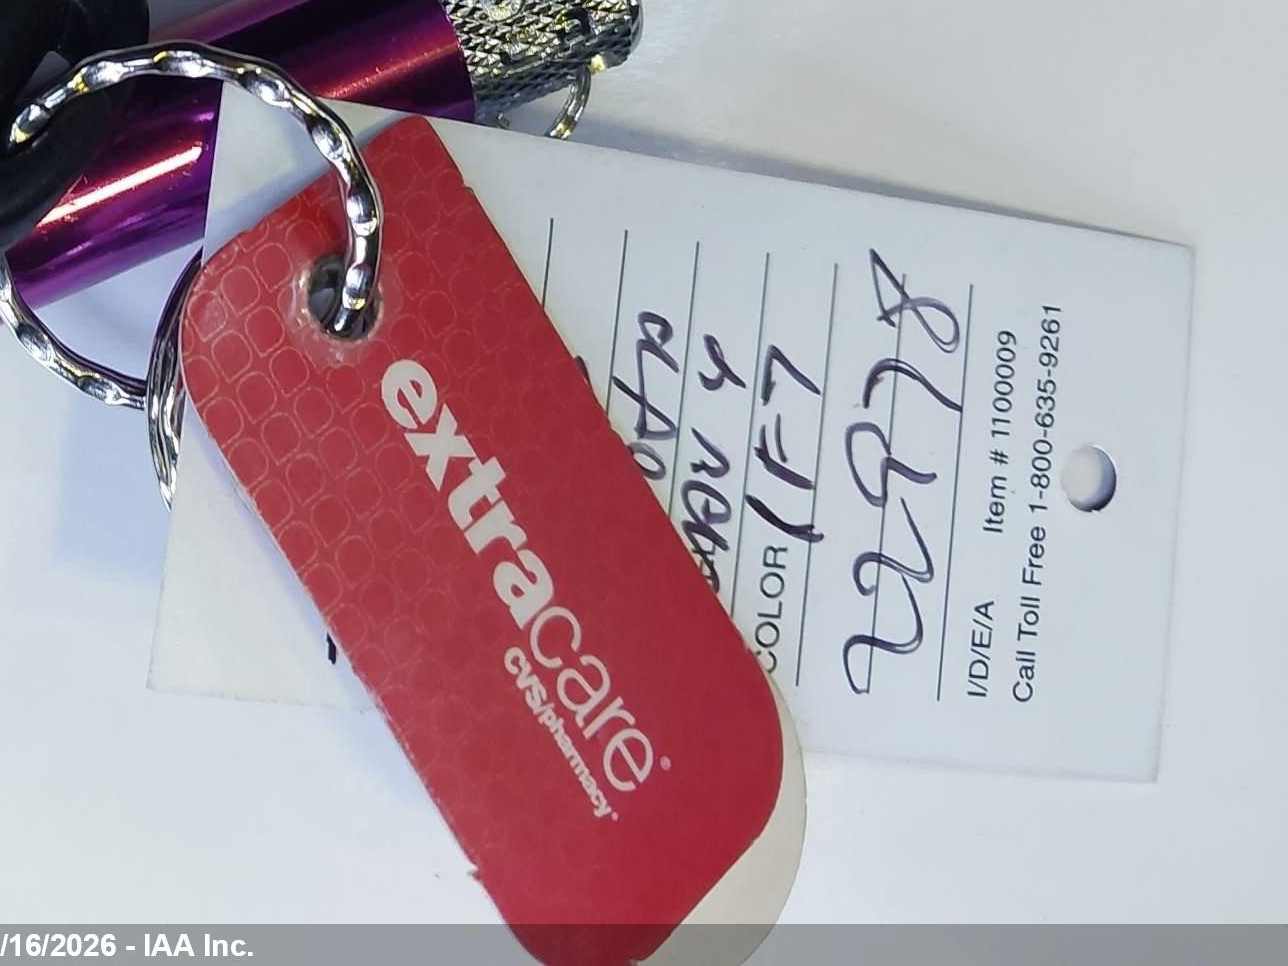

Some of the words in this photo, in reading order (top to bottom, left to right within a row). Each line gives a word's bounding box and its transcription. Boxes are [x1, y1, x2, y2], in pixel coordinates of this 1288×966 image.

[991, 330, 1017, 438] 1100009
[1028, 305, 1062, 513] 1-800-635-9261
[843, 248, 963, 694] 22978
[983, 475, 1007, 534] Item
[990, 449, 1009, 465] #
[381, 360, 653, 791] extracare
[1022, 526, 1046, 586] Free
[756, 545, 788, 673] COLOR
[967, 600, 995, 698] I/D/E/A
[1018, 596, 1041, 647] Toll
[1012, 650, 1036, 703] Call
[504, 647, 611, 817] CVS/pharmacy
